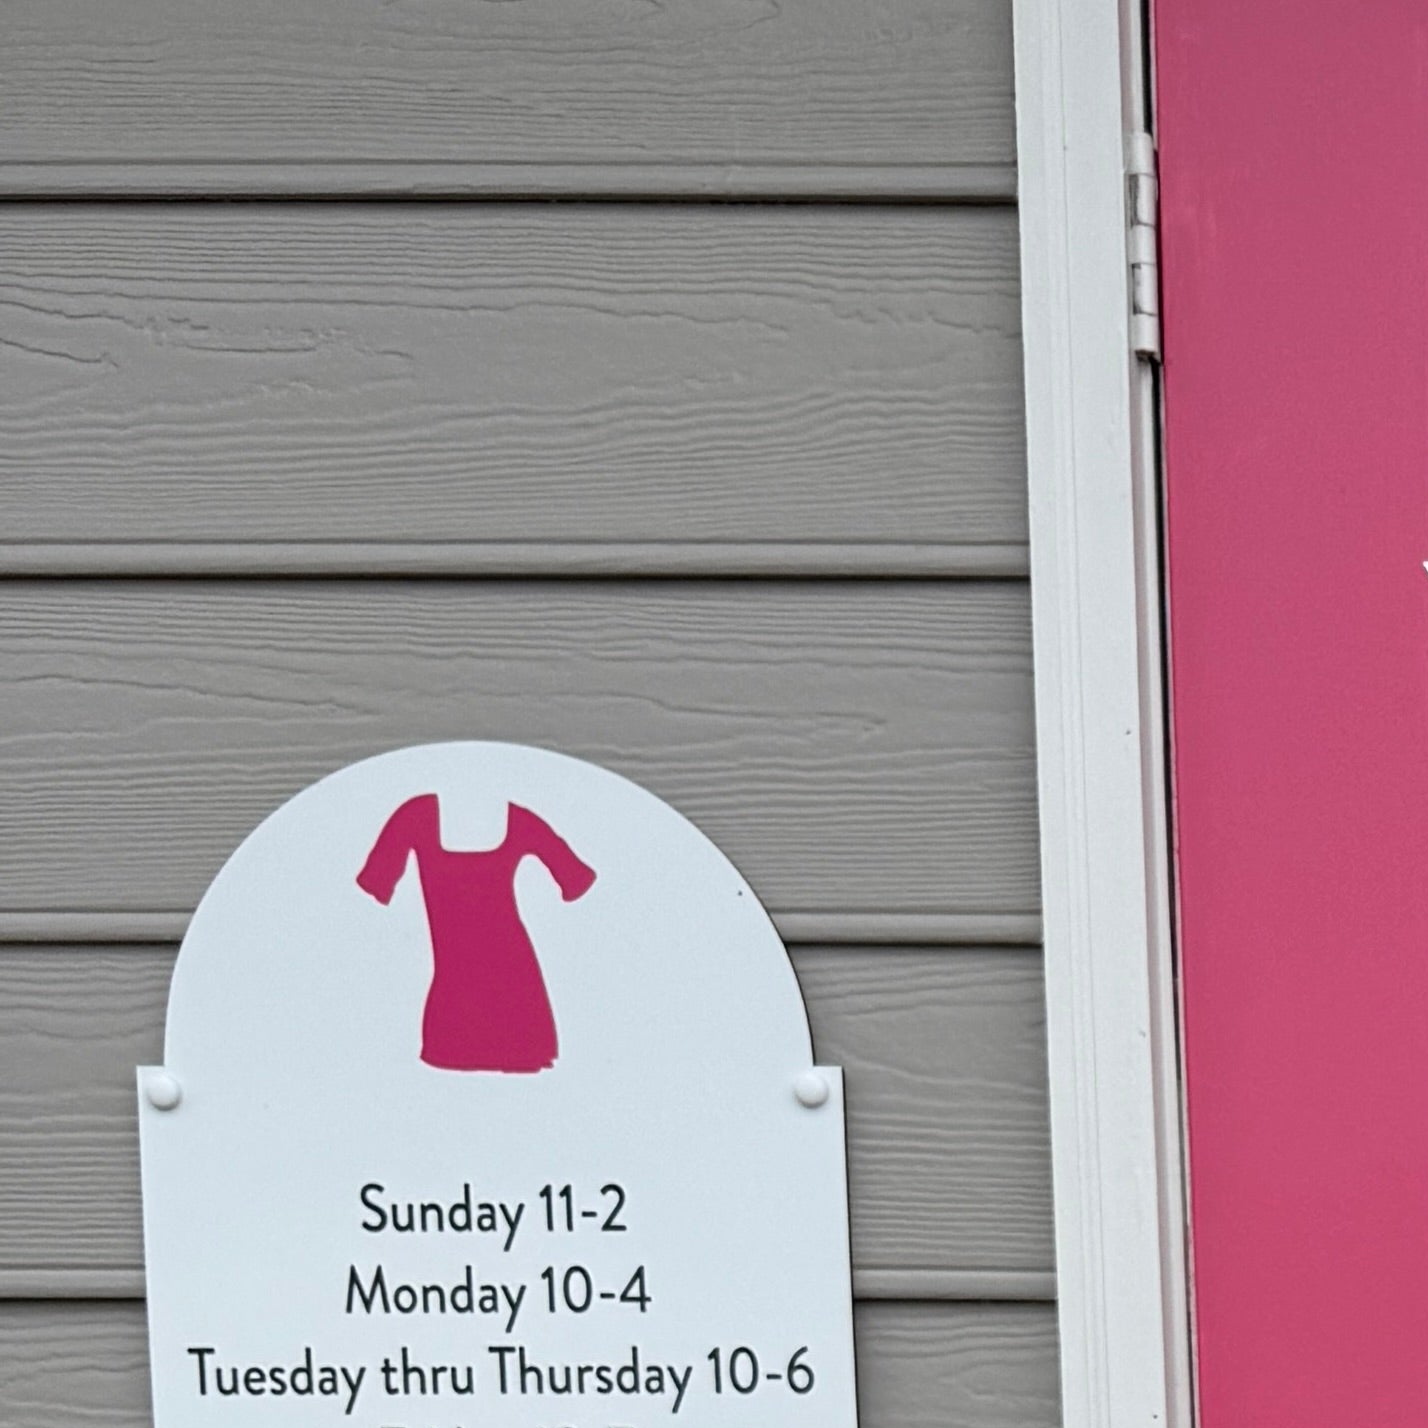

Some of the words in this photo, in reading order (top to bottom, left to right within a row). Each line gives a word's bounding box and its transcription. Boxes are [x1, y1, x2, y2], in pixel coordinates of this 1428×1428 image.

[360, 1182, 525, 1253] Sunday
[539, 1183, 628, 1233] 11-2
[345, 1264, 527, 1334] Monday
[540, 1265, 652, 1314] 10-4
[186, 1346, 367, 1416] Tuesday
[380, 1346, 475, 1396] thru
[487, 1345, 693, 1414] Thursday
[707, 1345, 816, 1395] 10-6
